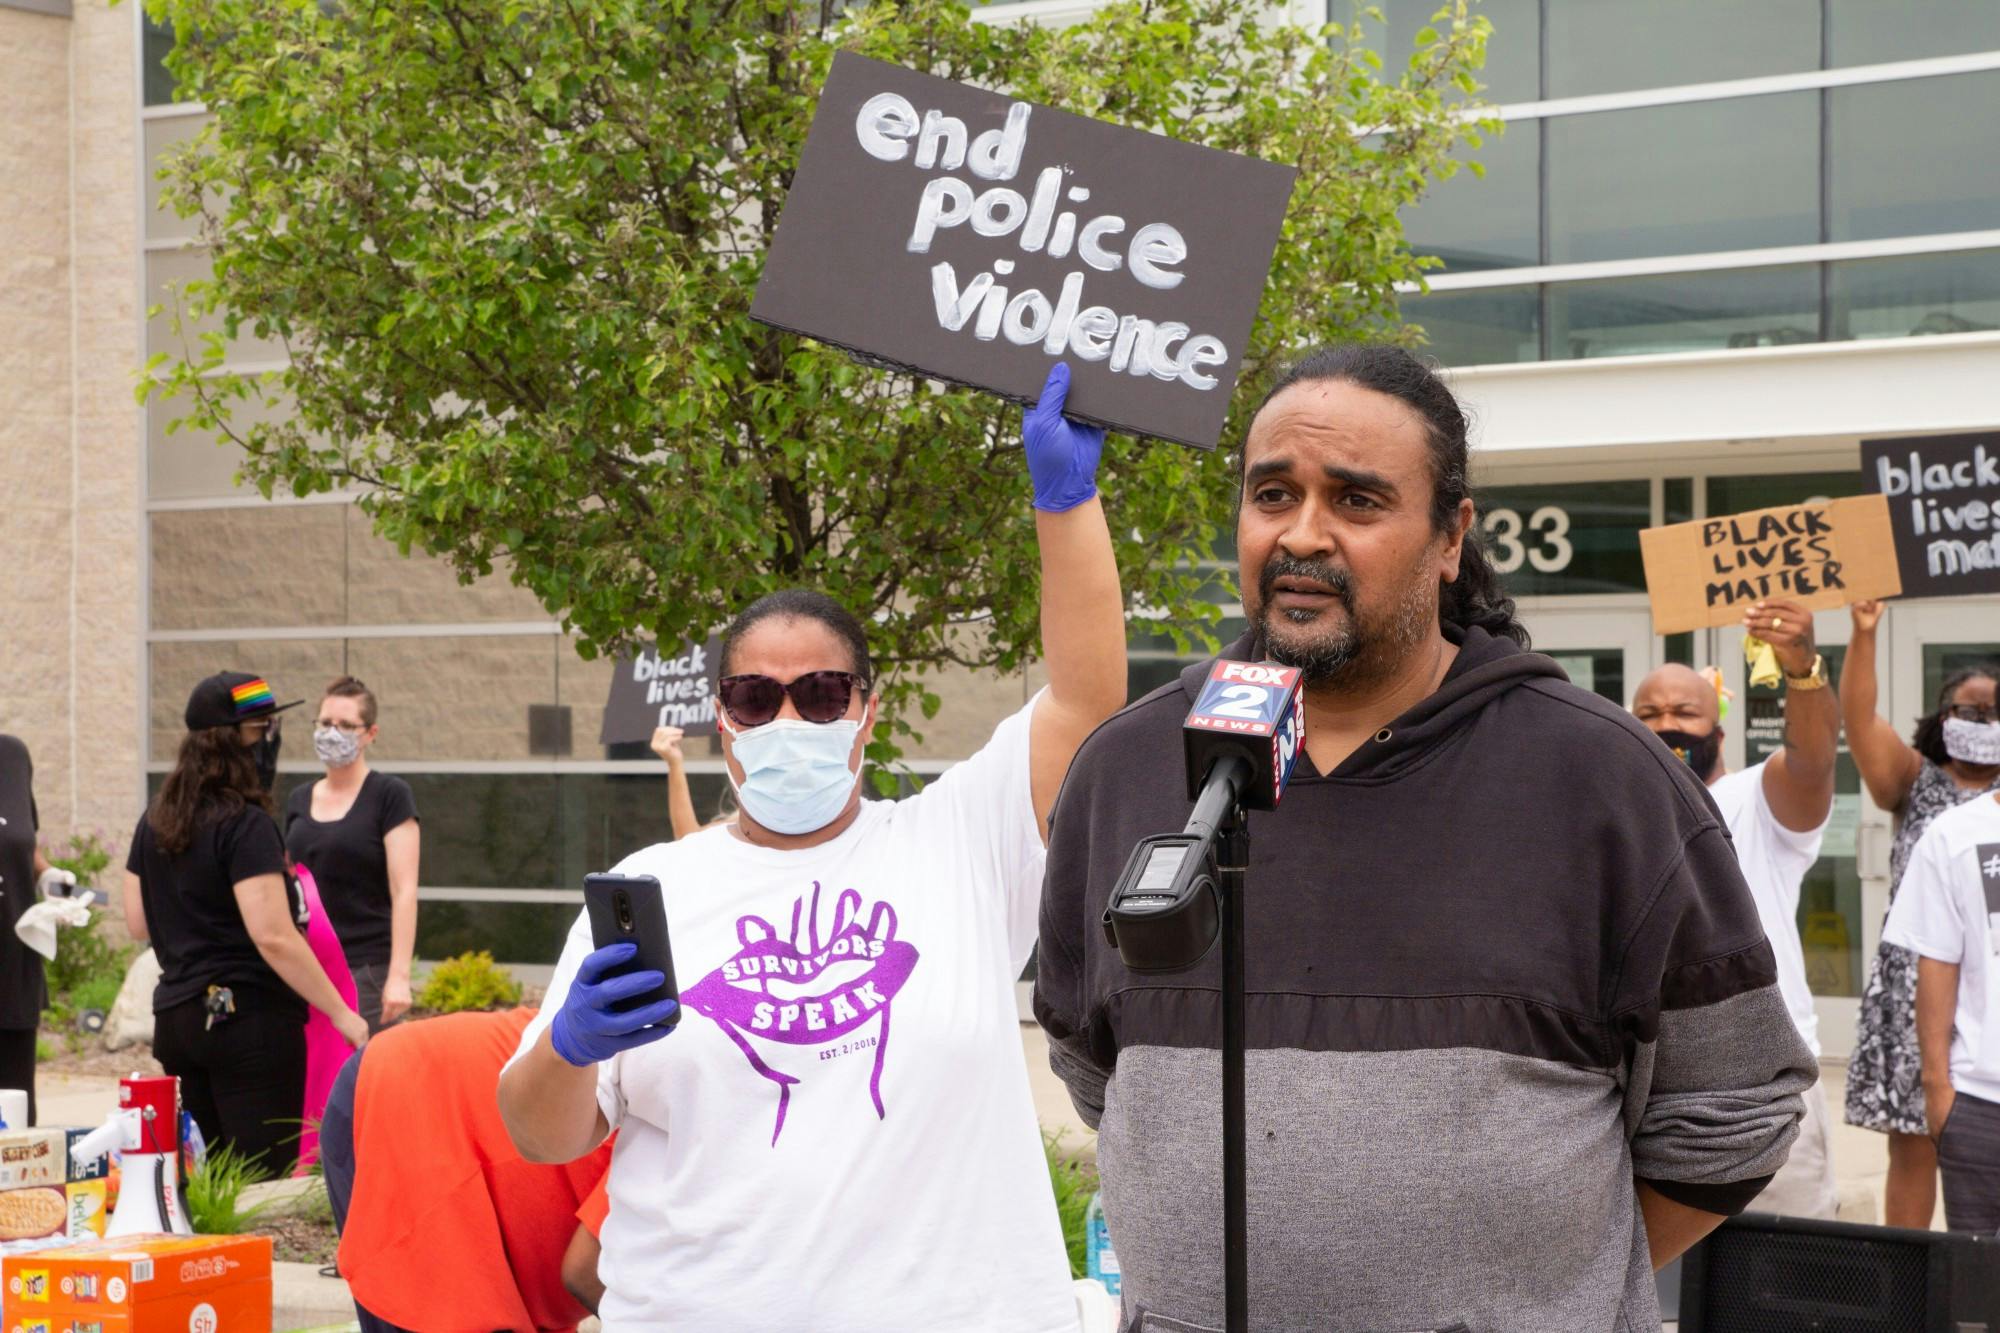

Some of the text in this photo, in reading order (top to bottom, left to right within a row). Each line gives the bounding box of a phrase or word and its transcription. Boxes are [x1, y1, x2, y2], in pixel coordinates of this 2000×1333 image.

[855, 91, 1033, 182] end
[906, 166, 1188, 290] police
[1877, 445, 2000, 496] black
[1474, 506, 1573, 574] 33
[1703, 510, 1832, 547] BLACK
[1713, 537, 1832, 574] LIVES
[1927, 532, 2000, 577] mat
[1706, 561, 1846, 607] MATTER
[633, 644, 706, 682] black
[1222, 664, 1288, 685] FOX
[646, 677, 710, 704] lives
[658, 694, 716, 727] matt
[1211, 685, 1268, 719] 2
[1194, 718, 1266, 732] NEWS
[1280, 717, 1295, 778] 2
[721, 935, 885, 980] SURVIVORS
[751, 981, 886, 1031] SPEAK
[819, 1037, 876, 1060] EST. 2/2018
